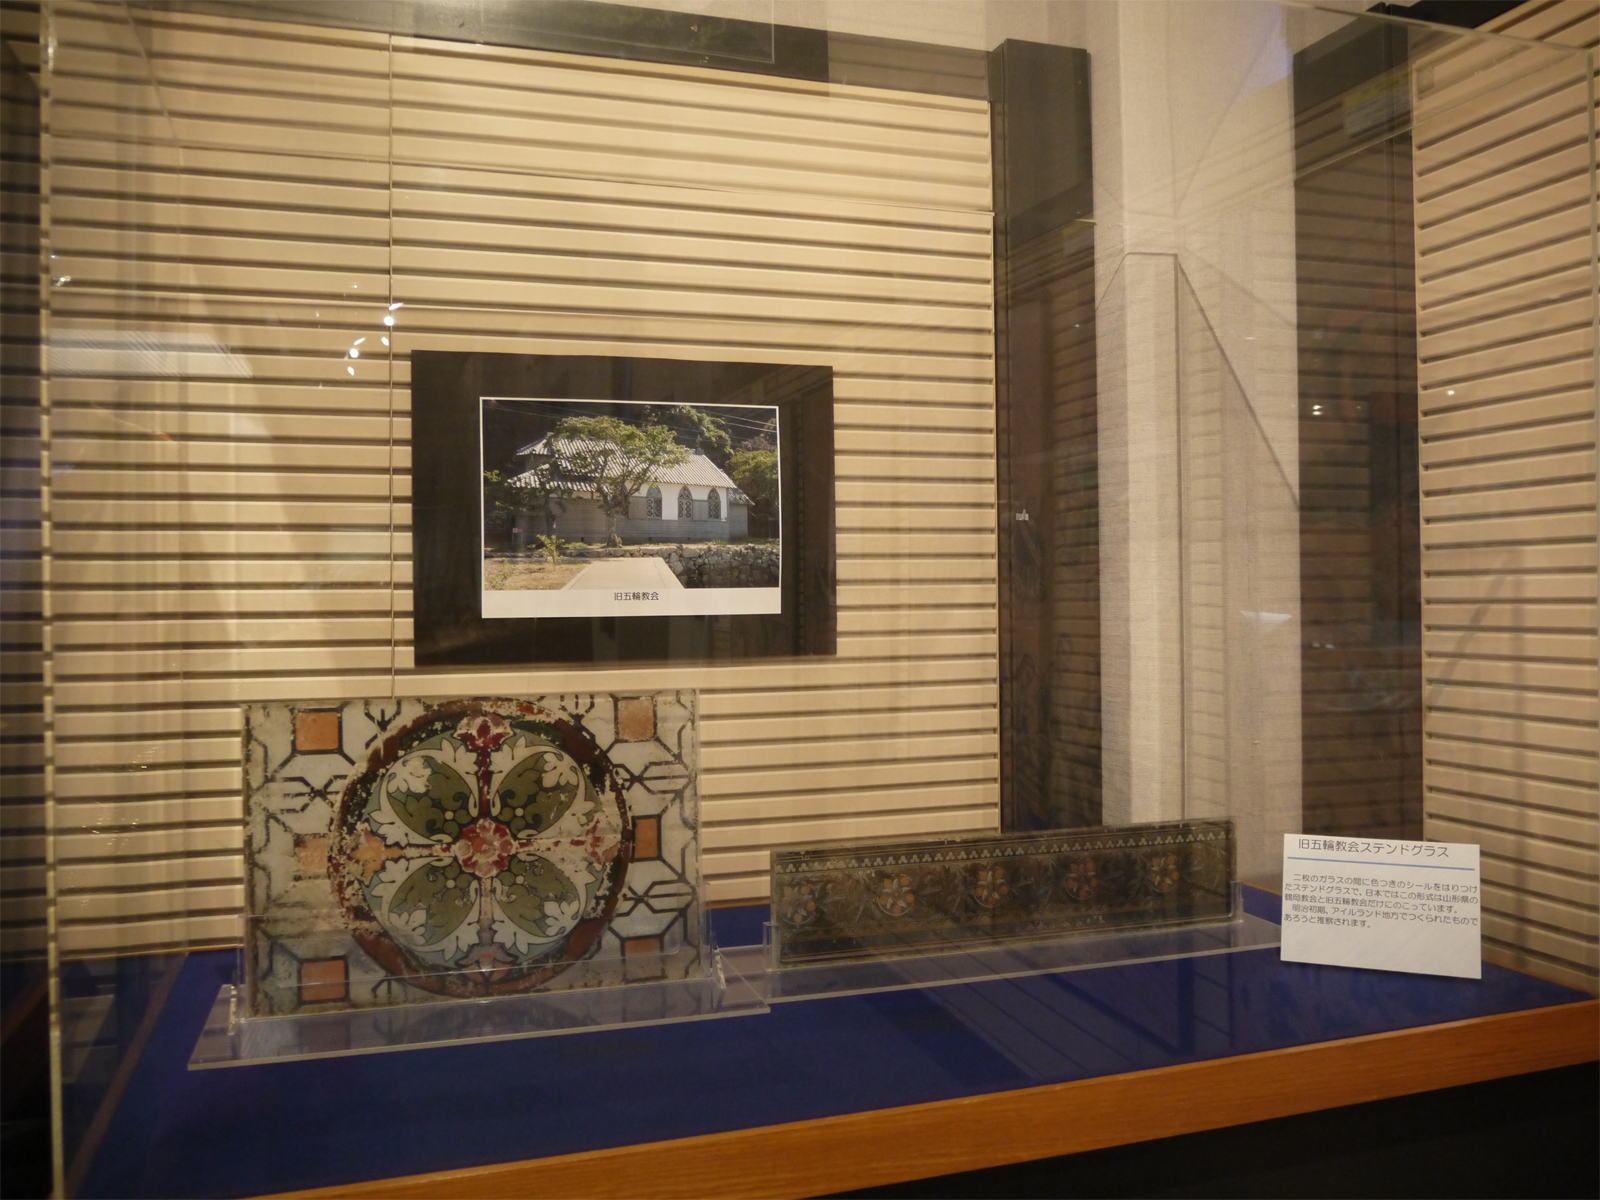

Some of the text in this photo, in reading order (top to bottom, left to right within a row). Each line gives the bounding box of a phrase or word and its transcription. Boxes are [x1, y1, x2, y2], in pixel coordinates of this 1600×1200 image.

[614, 591, 660, 601] 旧五輪教会
[1298, 838, 1450, 858] 旧五輪教会ステンドグラス
[1284, 883, 1479, 905] たステンドグラスで、日本ではこの形式は山形県の
[1293, 873, 1478, 894] 二枚のガラスの間に色つきのシールをはりつけ
[1292, 903, 1479, 926] 明治初期、アイルランド地方でつくられたもので
